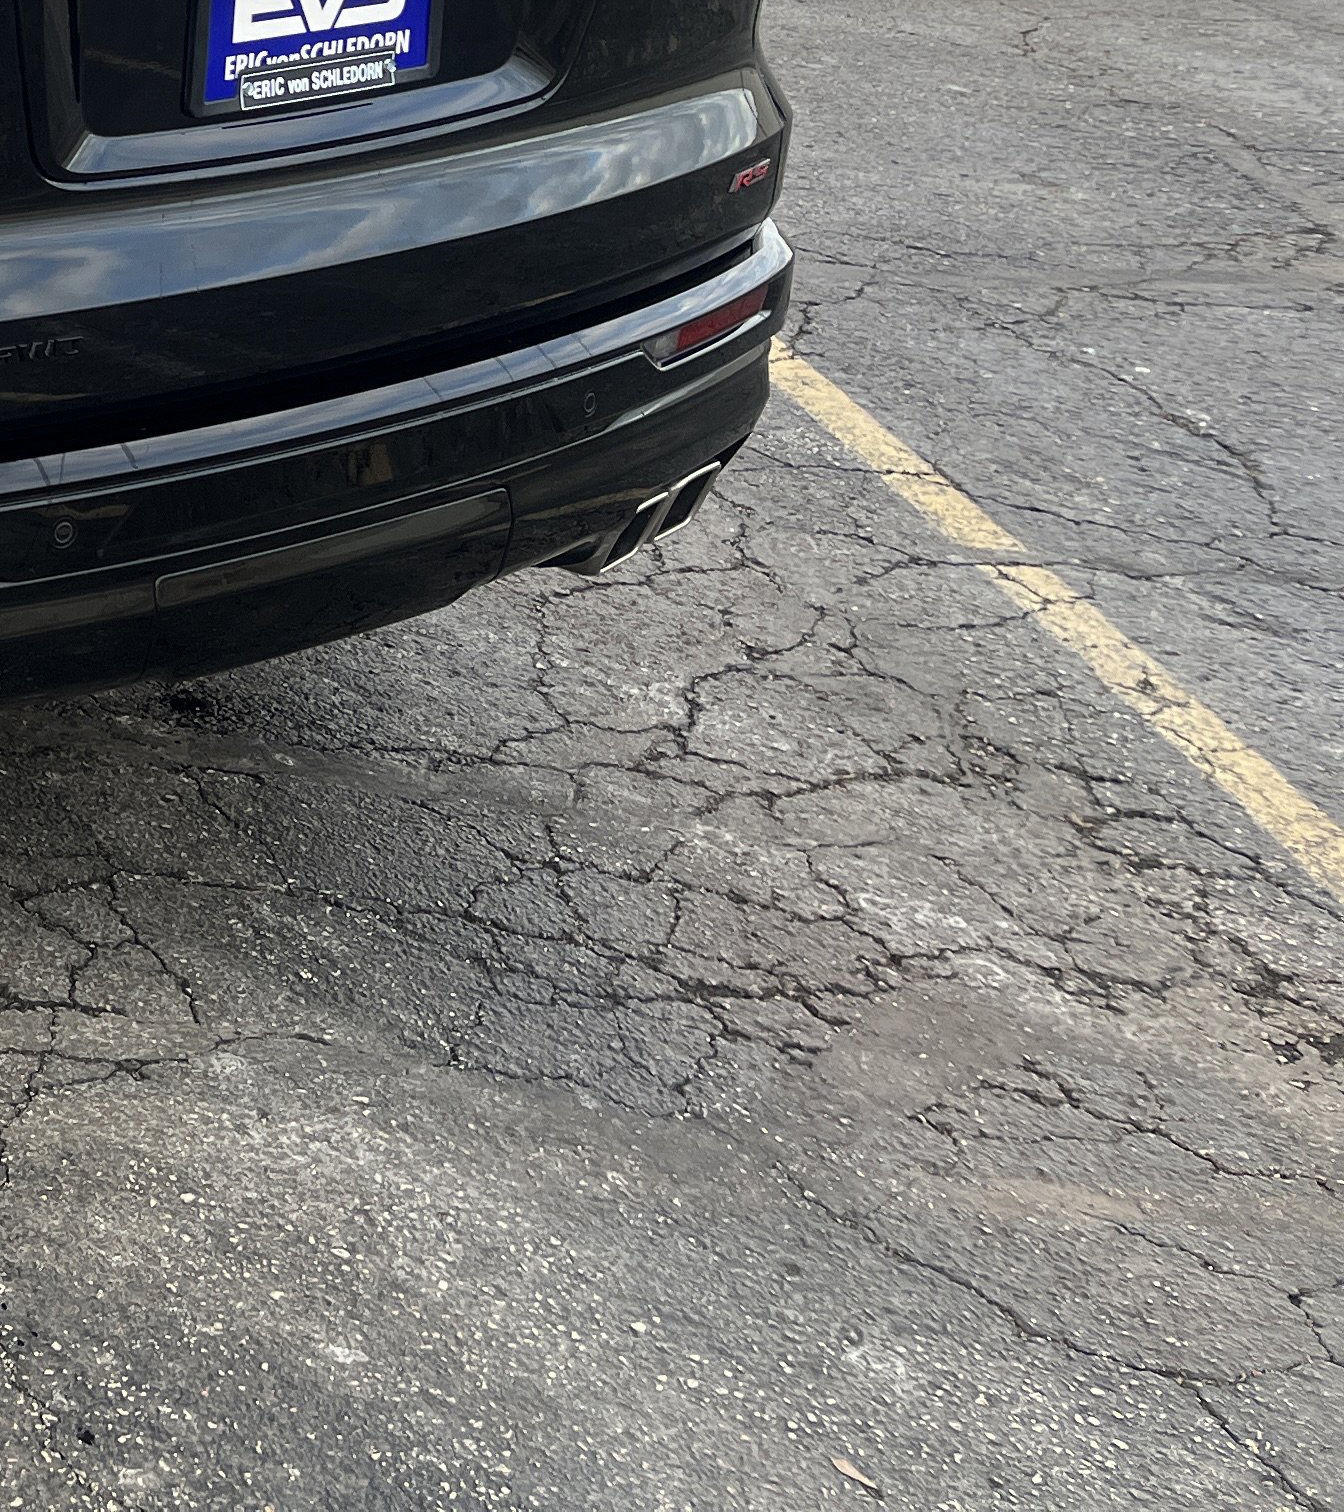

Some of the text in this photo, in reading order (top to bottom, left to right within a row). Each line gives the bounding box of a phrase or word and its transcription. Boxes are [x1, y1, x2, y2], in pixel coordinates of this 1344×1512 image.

[252, 61, 384, 100] ERIC von SCHLEDORN
[728, 158, 771, 193] RS
